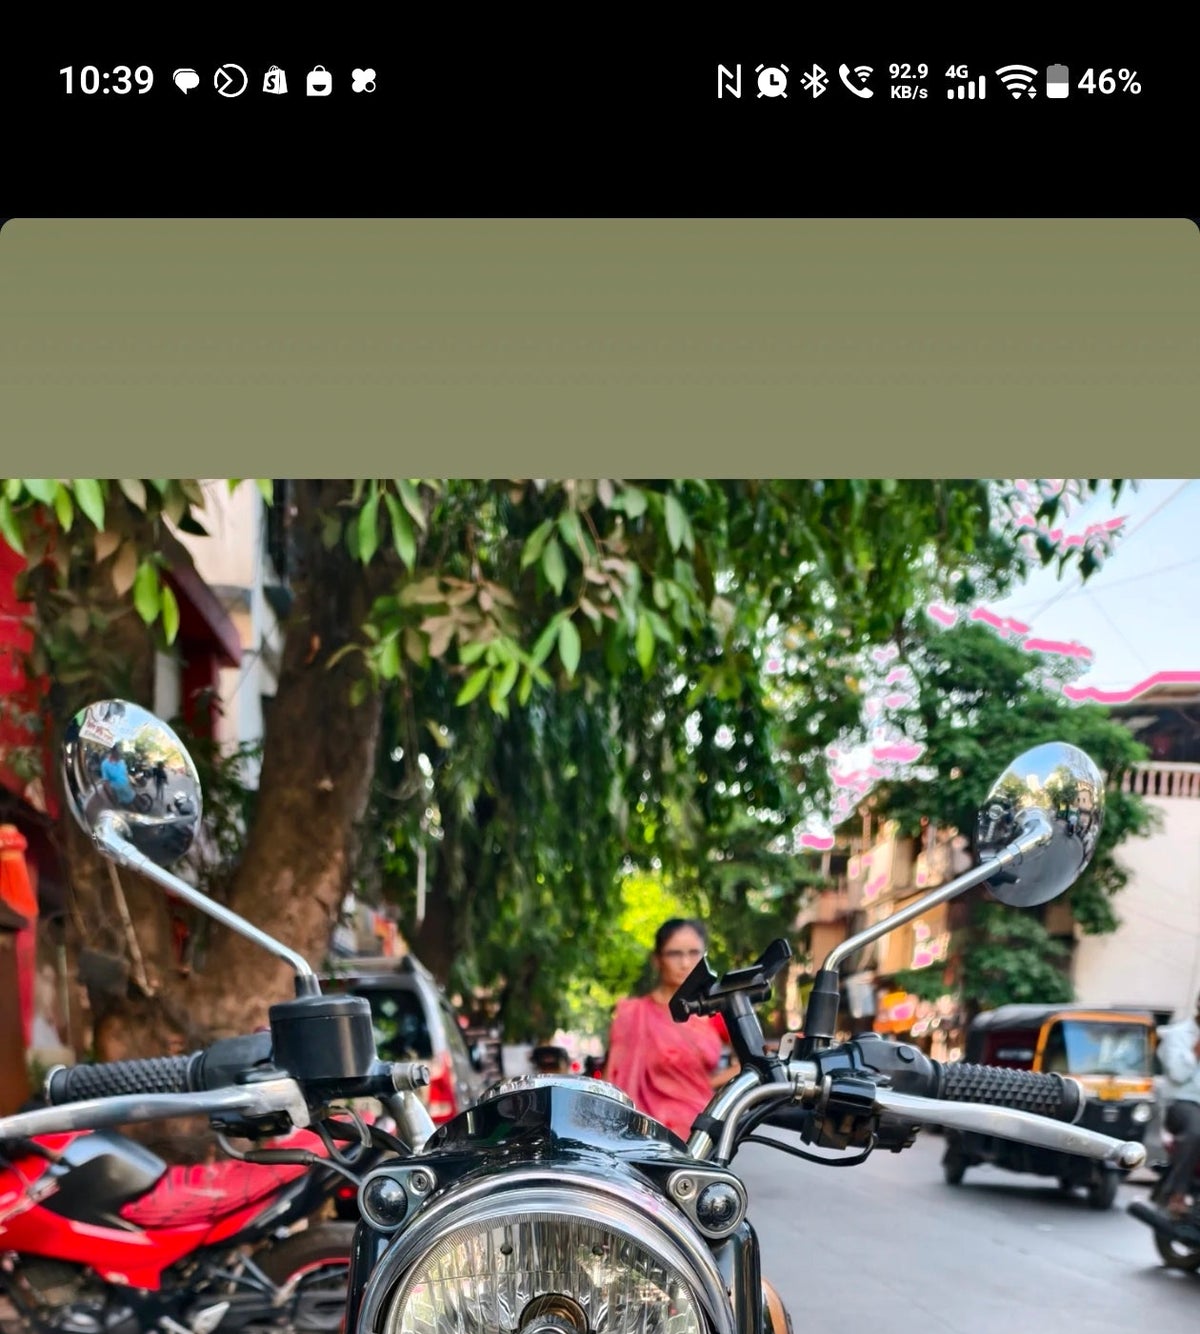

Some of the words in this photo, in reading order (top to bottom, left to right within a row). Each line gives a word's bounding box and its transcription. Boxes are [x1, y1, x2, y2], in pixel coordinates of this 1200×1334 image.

[888, 63, 929, 79] 92.9
[944, 64, 969, 79] 4G
[60, 66, 154, 95] 10:39
[1077, 67, 1142, 95] 46%
[890, 85, 929, 101] KB/s
